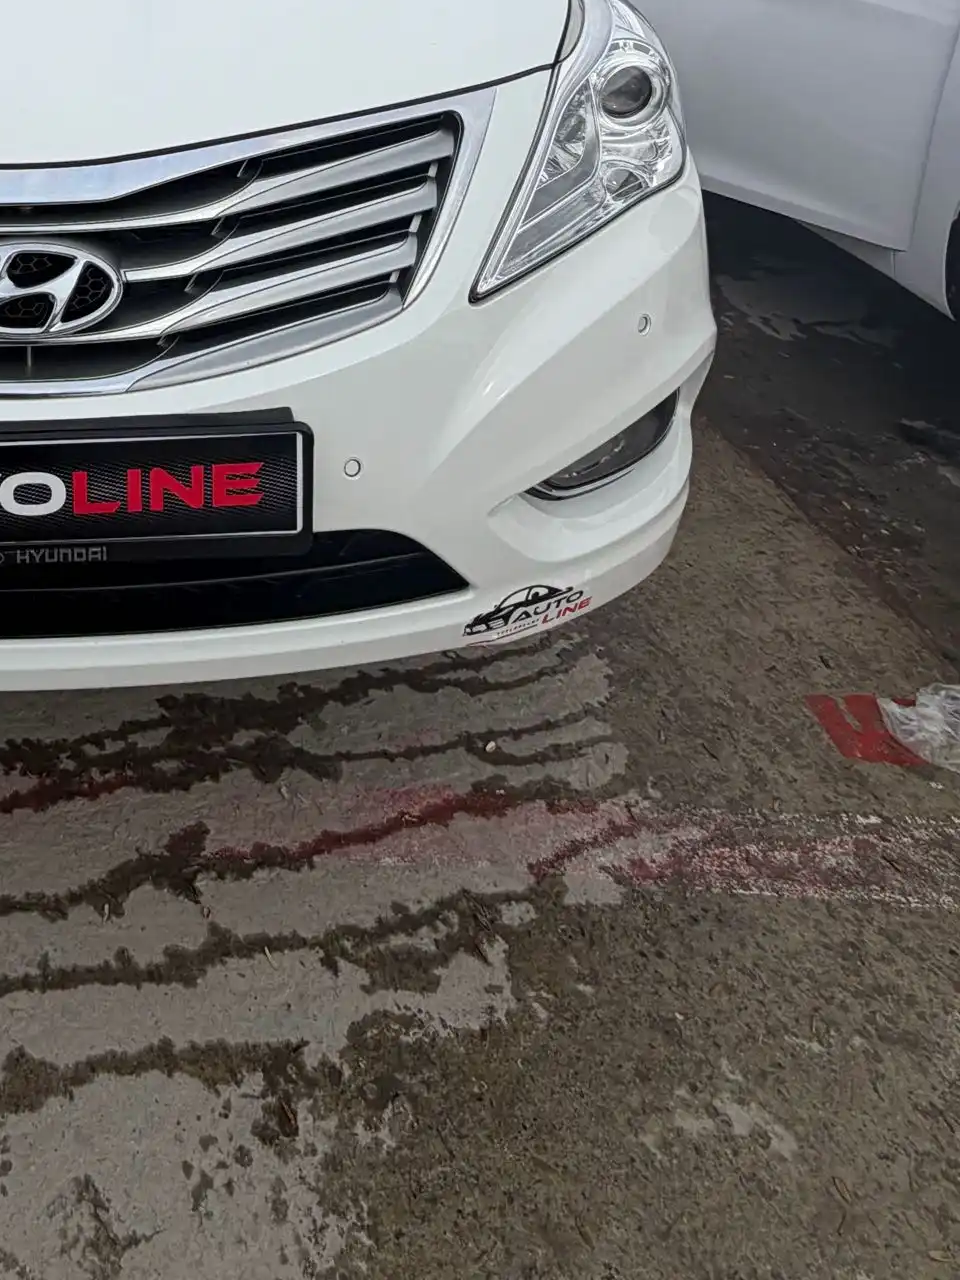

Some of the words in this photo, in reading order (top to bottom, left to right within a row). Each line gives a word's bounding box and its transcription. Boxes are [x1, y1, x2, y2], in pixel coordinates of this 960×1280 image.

[16, 546, 107, 563] HYUNDAI
[511, 590, 583, 624] AUTO
[542, 596, 592, 624] LINE
